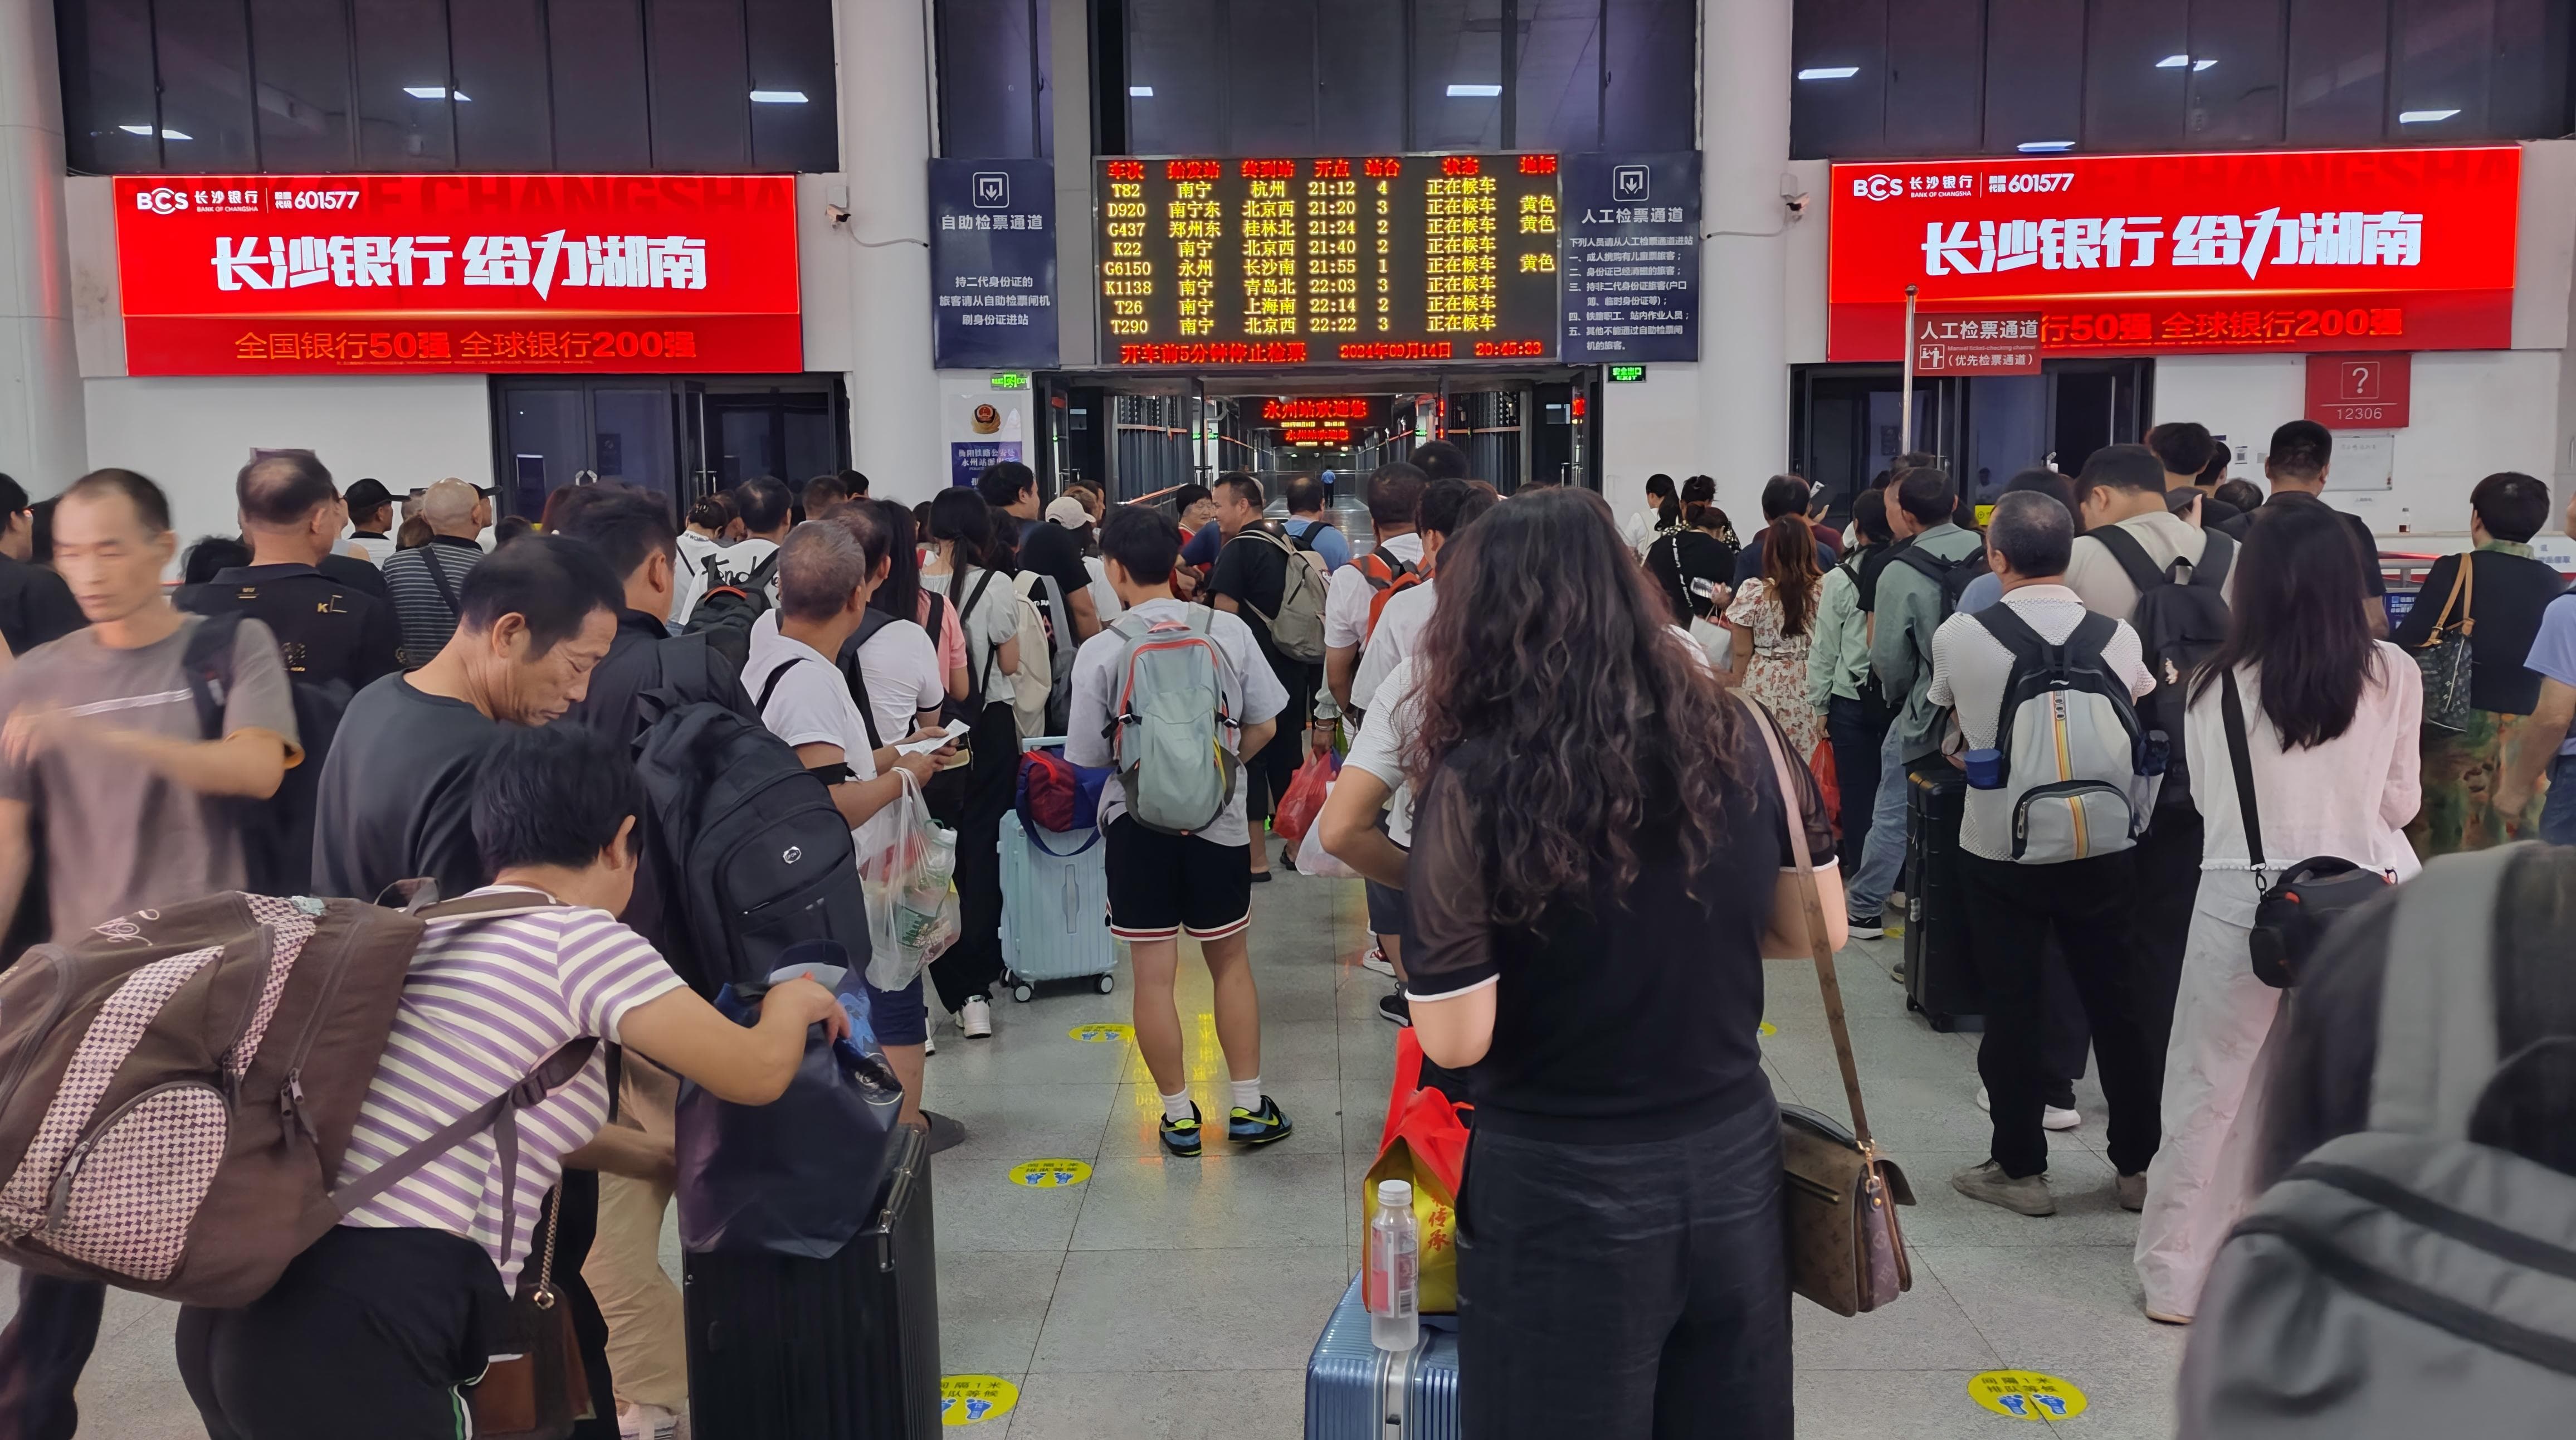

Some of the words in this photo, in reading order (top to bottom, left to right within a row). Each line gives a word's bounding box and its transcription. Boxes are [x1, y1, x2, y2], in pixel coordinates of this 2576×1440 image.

[1108, 161, 1145, 179] 车次
[1167, 160, 1221, 179] 始发站
[1241, 160, 1295, 178] 终到站
[1315, 159, 1351, 177] 开点
[1364, 158, 1401, 177] 站台
[1441, 157, 1479, 176] 状态
[1111, 183, 1140, 198] T82
[1177, 181, 1212, 198] 南宁
[1252, 181, 1286, 198] 杭州
[1308, 181, 1355, 196] 21:12
[1377, 181, 1388, 195] 4
[1426, 177, 1496, 196] 正在候车
[1853, 177, 1903, 198] BCS
[1910, 175, 1973, 189] 长沙银行
[2008, 173, 2075, 193] 601577
[137, 191, 189, 211] BCS
[194, 191, 258, 204] 长沙银行
[294, 191, 360, 209] 601577
[1108, 203, 1145, 218] D920
[1169, 201, 1221, 218] 南宁东
[1242, 200, 1295, 218] 北京西
[1309, 201, 1355, 216] 21:20
[1377, 201, 1388, 215] 3
[1426, 197, 1496, 216] 正在候车
[1519, 195, 1556, 215] 黄色
[941, 215, 1043, 230] 自助检票通道
[1582, 207, 1684, 224] 人工检票通道
[1109, 222, 1146, 237] G437
[1169, 221, 1222, 238] 郑州东
[1243, 220, 1296, 237] 桂林北
[1309, 220, 1355, 235] 21:24
[1377, 220, 1388, 235] 2
[1426, 216, 1496, 235] 正在候车
[1519, 215, 1556, 234] 黄色
[1113, 242, 1141, 257] K22
[1178, 240, 1213, 257] 南宁
[1243, 240, 1295, 257] 北京西
[1309, 240, 1356, 255] 21:40
[1377, 240, 1388, 255] 2
[1426, 236, 1496, 255] 正在候车
[1921, 216, 2164, 276] 长沙银行
[2172, 207, 2423, 281] 给力湖南
[211, 236, 453, 291] 长沙银行
[462, 229, 707, 301] 给力湖南
[1105, 261, 1151, 276] G6150
[1178, 260, 1212, 277] 永州
[1243, 259, 1295, 276] 长沙南
[1309, 259, 1356, 274] 21:55
[1378, 259, 1388, 274] 1
[1426, 255, 1496, 274] 正在候车
[1519, 254, 1556, 273] 黄色
[955, 276, 1033, 288] 持二代身份证的
[1105, 281, 1152, 295] K1138
[1179, 279, 1213, 296] 南宁
[1243, 279, 1297, 296] 青岛北
[1309, 279, 1356, 294] 22:03
[1378, 279, 1388, 293] 3
[1426, 275, 1496, 294] 正在候车
[939, 295, 1051, 307] 旅客请从自助检票闸机
[1114, 300, 1143, 315] T26
[1179, 298, 1214, 316] 南宁
[1243, 298, 1296, 315] 上海南
[1310, 298, 1356, 313] 22:14
[1378, 298, 1388, 313] 2
[1426, 294, 1496, 313] 正在候车
[962, 314, 1028, 326] 刷身份证进站
[1111, 320, 1148, 334] T290
[1179, 318, 1214, 335] 南宁
[1244, 317, 1297, 335] 北京西
[1310, 317, 1357, 333] 22:22
[1378, 317, 1388, 333] 3
[1426, 314, 1497, 333] 正在候车
[1920, 319, 2038, 339] 人工检票通道
[2162, 308, 2403, 339] 全球银行200强
[235, 332, 451, 359] 全国银行50强
[460, 330, 696, 359] 全球银行200强
[1121, 342, 1306, 364] 开车前5分钟停止检票
[1263, 400, 1367, 419] 永州站欢迎您
[2337, 407, 2382, 420] 12306
[961, 458, 1009, 466] 永州站派出
